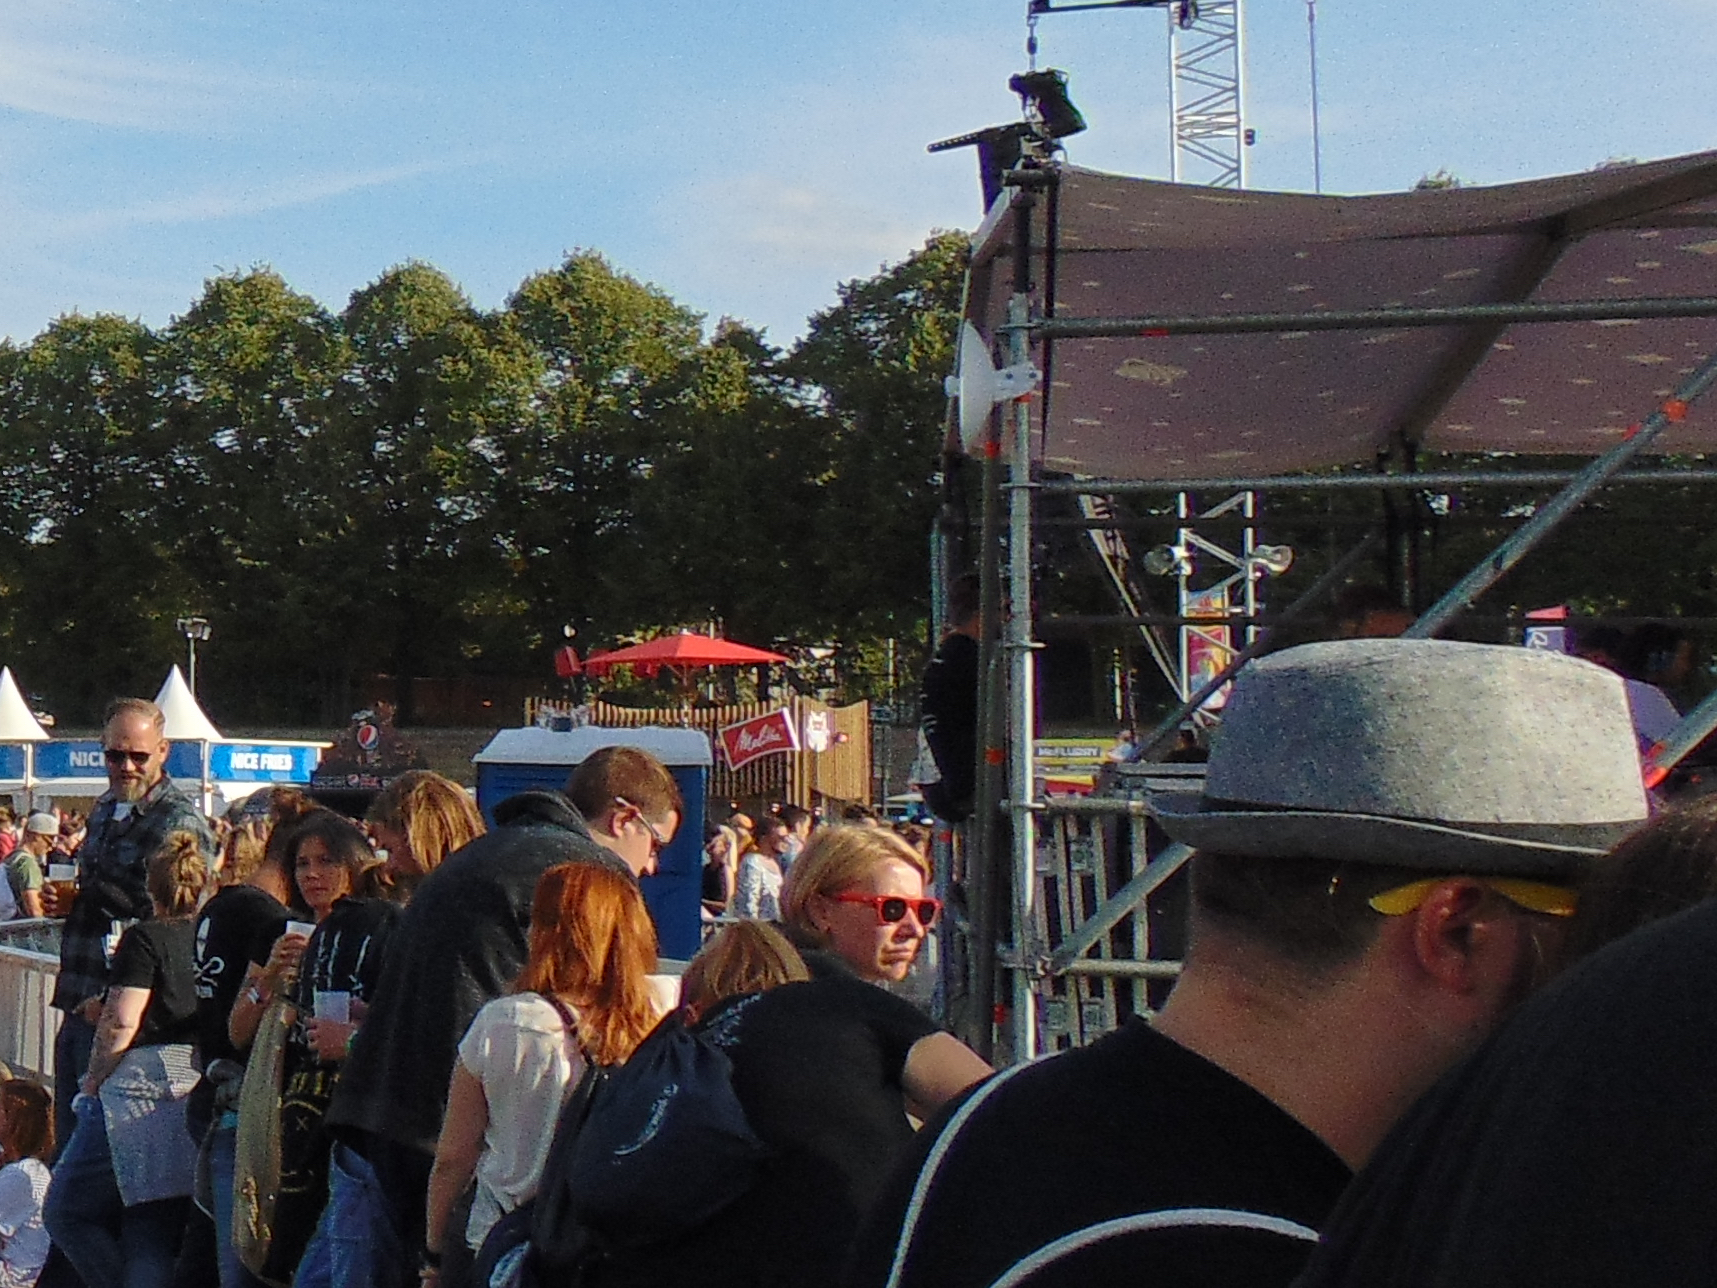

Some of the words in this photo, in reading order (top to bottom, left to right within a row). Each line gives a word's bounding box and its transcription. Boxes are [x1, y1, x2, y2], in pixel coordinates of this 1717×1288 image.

[69, 750, 105, 767] NIC
[231, 753, 258, 770] NICE
[260, 754, 293, 771] FRIES
